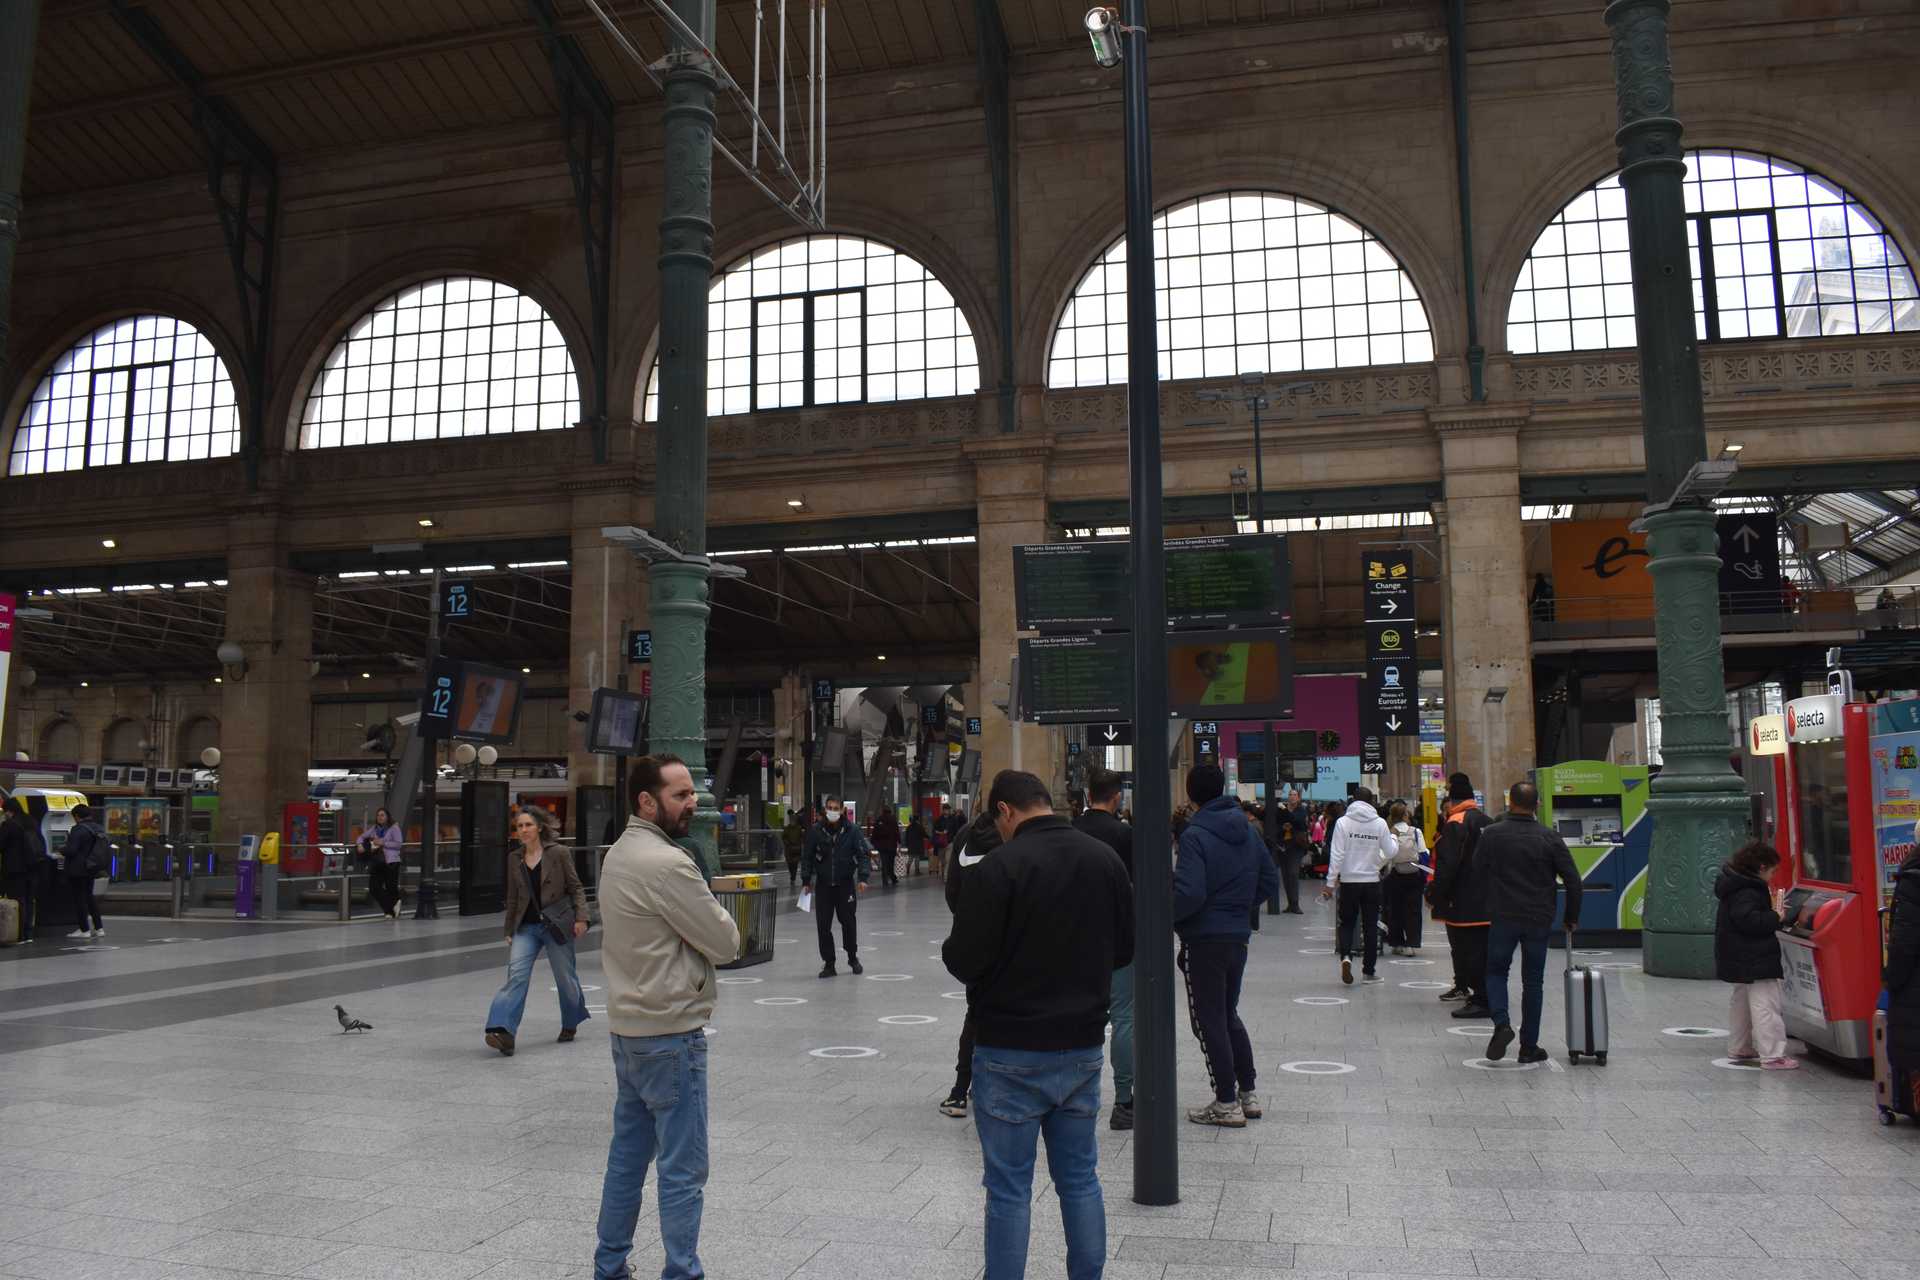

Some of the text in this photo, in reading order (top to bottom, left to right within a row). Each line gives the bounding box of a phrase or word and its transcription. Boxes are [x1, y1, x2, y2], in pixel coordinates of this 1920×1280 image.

[1375, 582, 1401, 591] Change
[448, 593, 467, 613] 12
[1383, 634, 1398, 643] BUS
[635, 640, 652, 656] 13
[817, 686, 831, 697] 14
[432, 688, 451, 713] 12
[1797, 710, 1824, 728] selecta
[970, 721, 981, 732] 16
[1208, 725, 1217, 734] 21
[1760, 729, 1778, 742] selecta
[1884, 841, 1917, 864] HARIB
